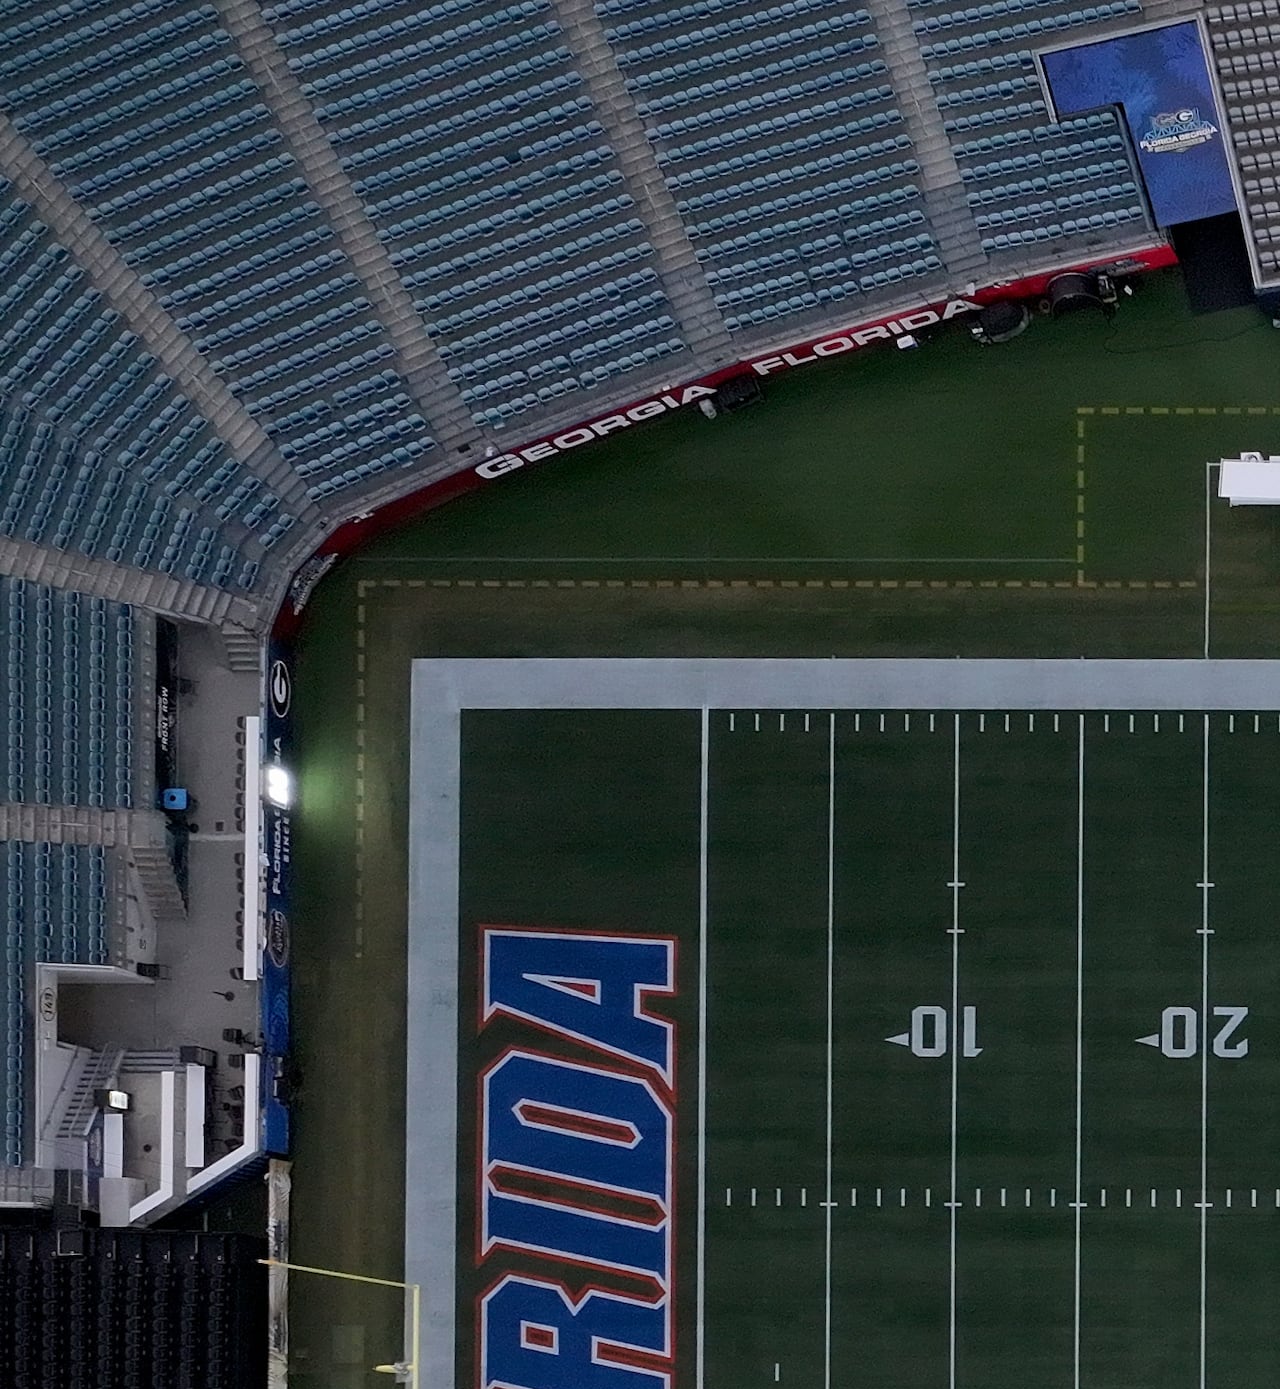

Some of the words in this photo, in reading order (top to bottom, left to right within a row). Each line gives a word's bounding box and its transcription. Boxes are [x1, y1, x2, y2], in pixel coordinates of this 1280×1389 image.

[751, 299, 985, 376] FLORIDA
[474, 385, 718, 480] GEORGIA
[272, 819, 282, 895] FLORIDA
[912, 1005, 983, 1057] 10
[1162, 1006, 1249, 1058] 20
